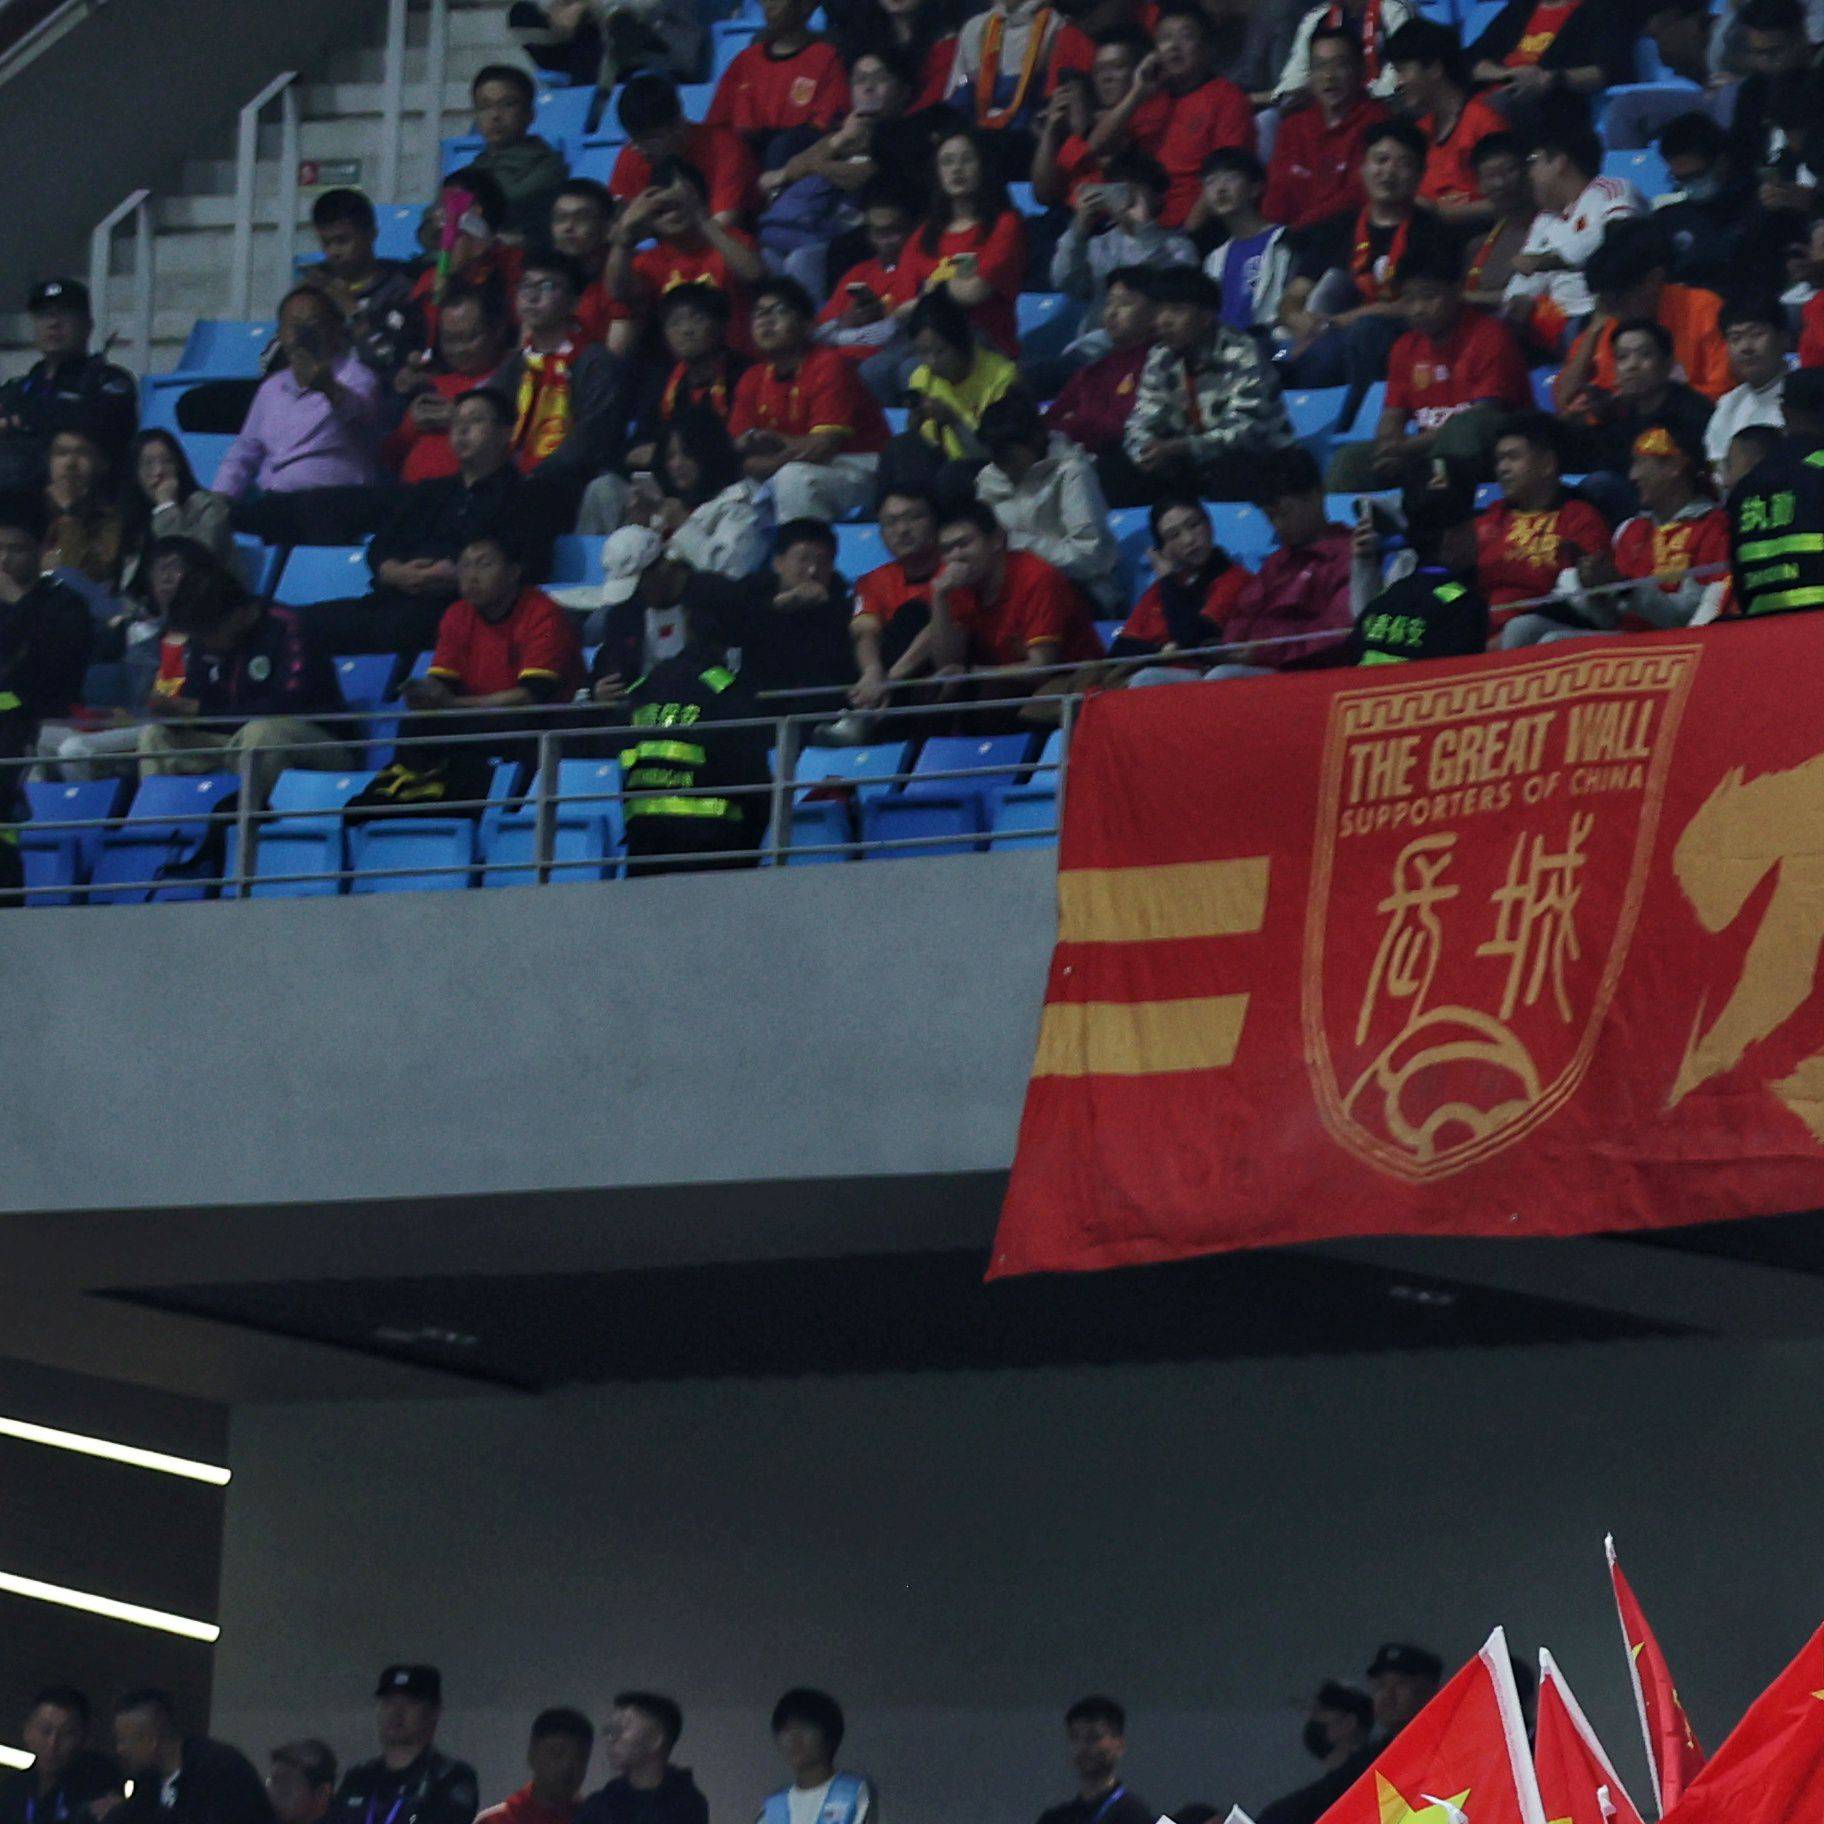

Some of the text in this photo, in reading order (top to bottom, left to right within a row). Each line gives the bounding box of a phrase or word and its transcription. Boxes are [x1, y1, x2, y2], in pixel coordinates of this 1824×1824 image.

[1350, 698, 1655, 802] THE GREAT WALL
[1338, 763, 1643, 838] SUPPORTERS OF CHINA
